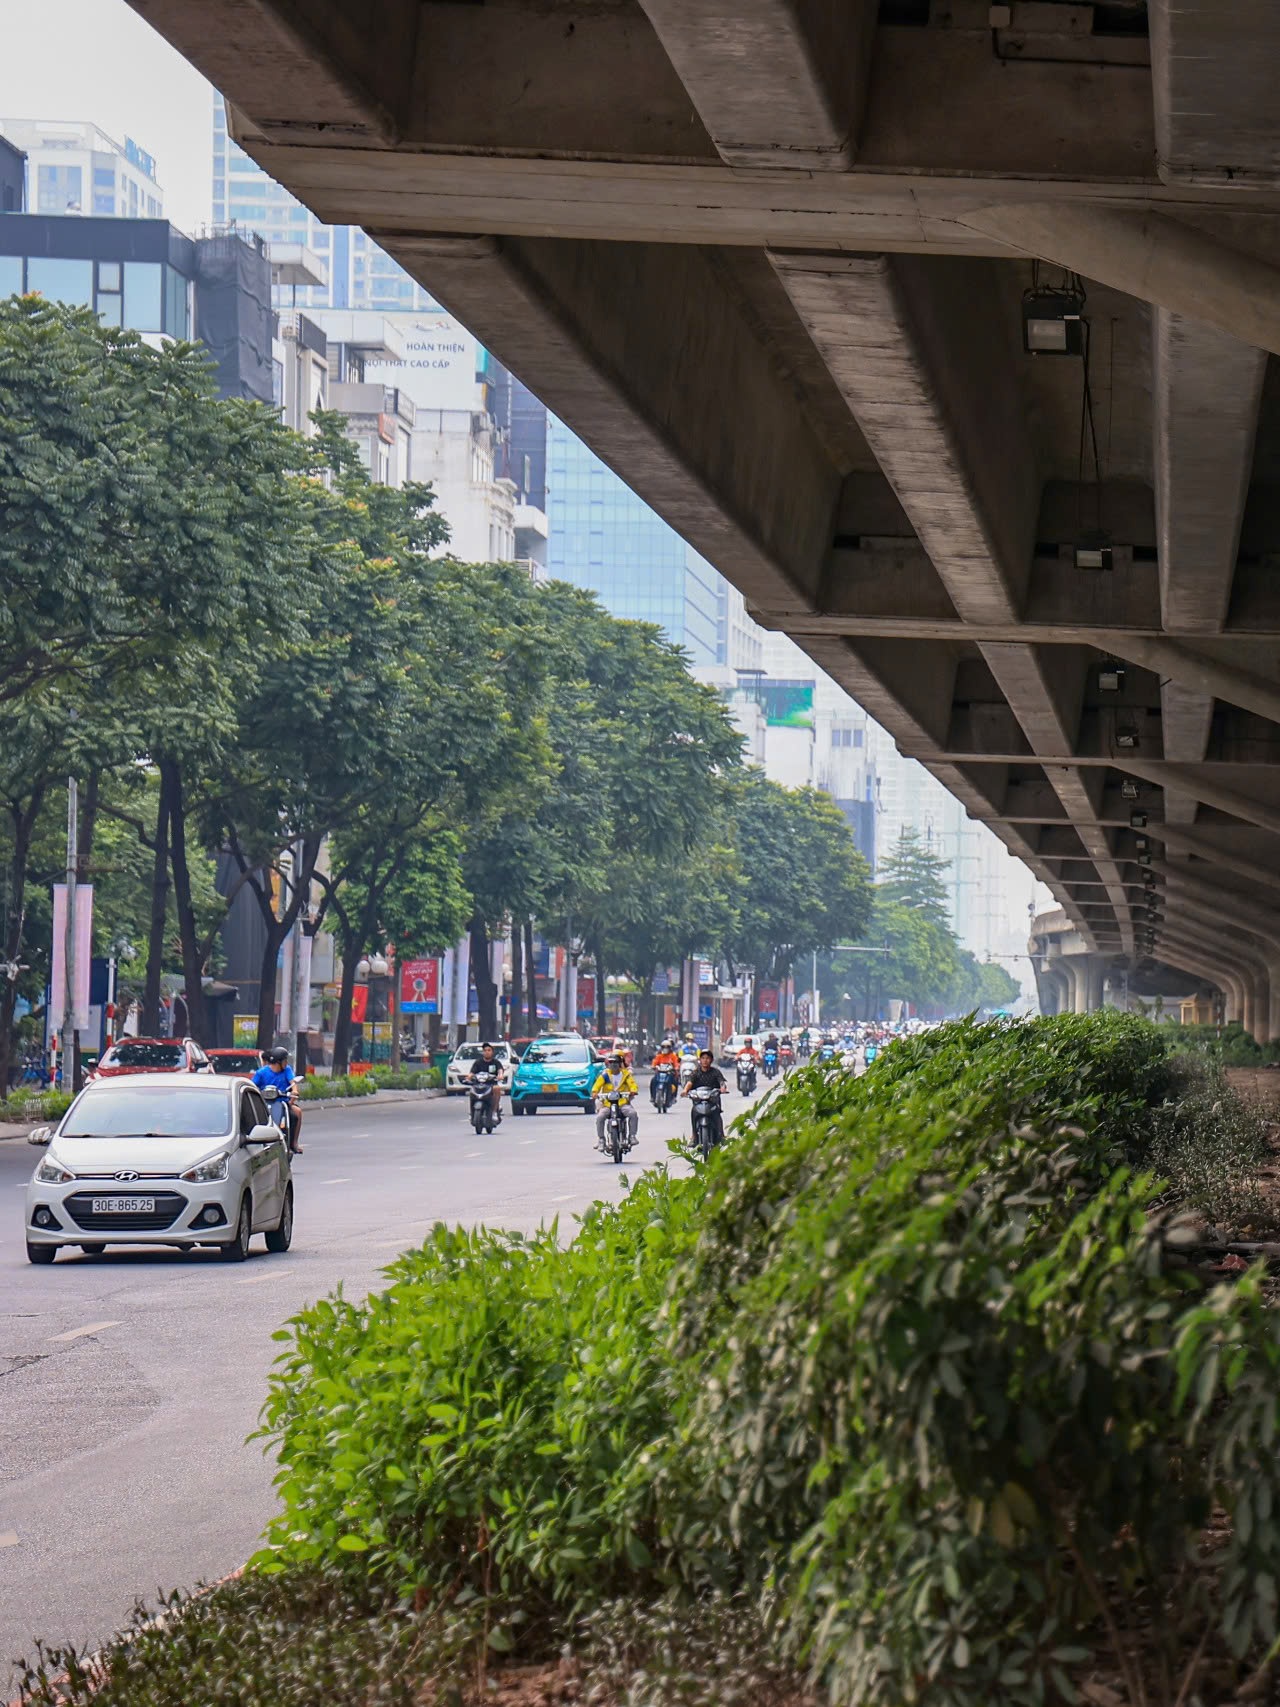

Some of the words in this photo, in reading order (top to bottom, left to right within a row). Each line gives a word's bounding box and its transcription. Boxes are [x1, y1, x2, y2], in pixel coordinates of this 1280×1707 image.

[406, 342, 434, 352] HOÀN
[438, 343, 465, 354] THIỆN
[410, 360, 430, 368] CAO
